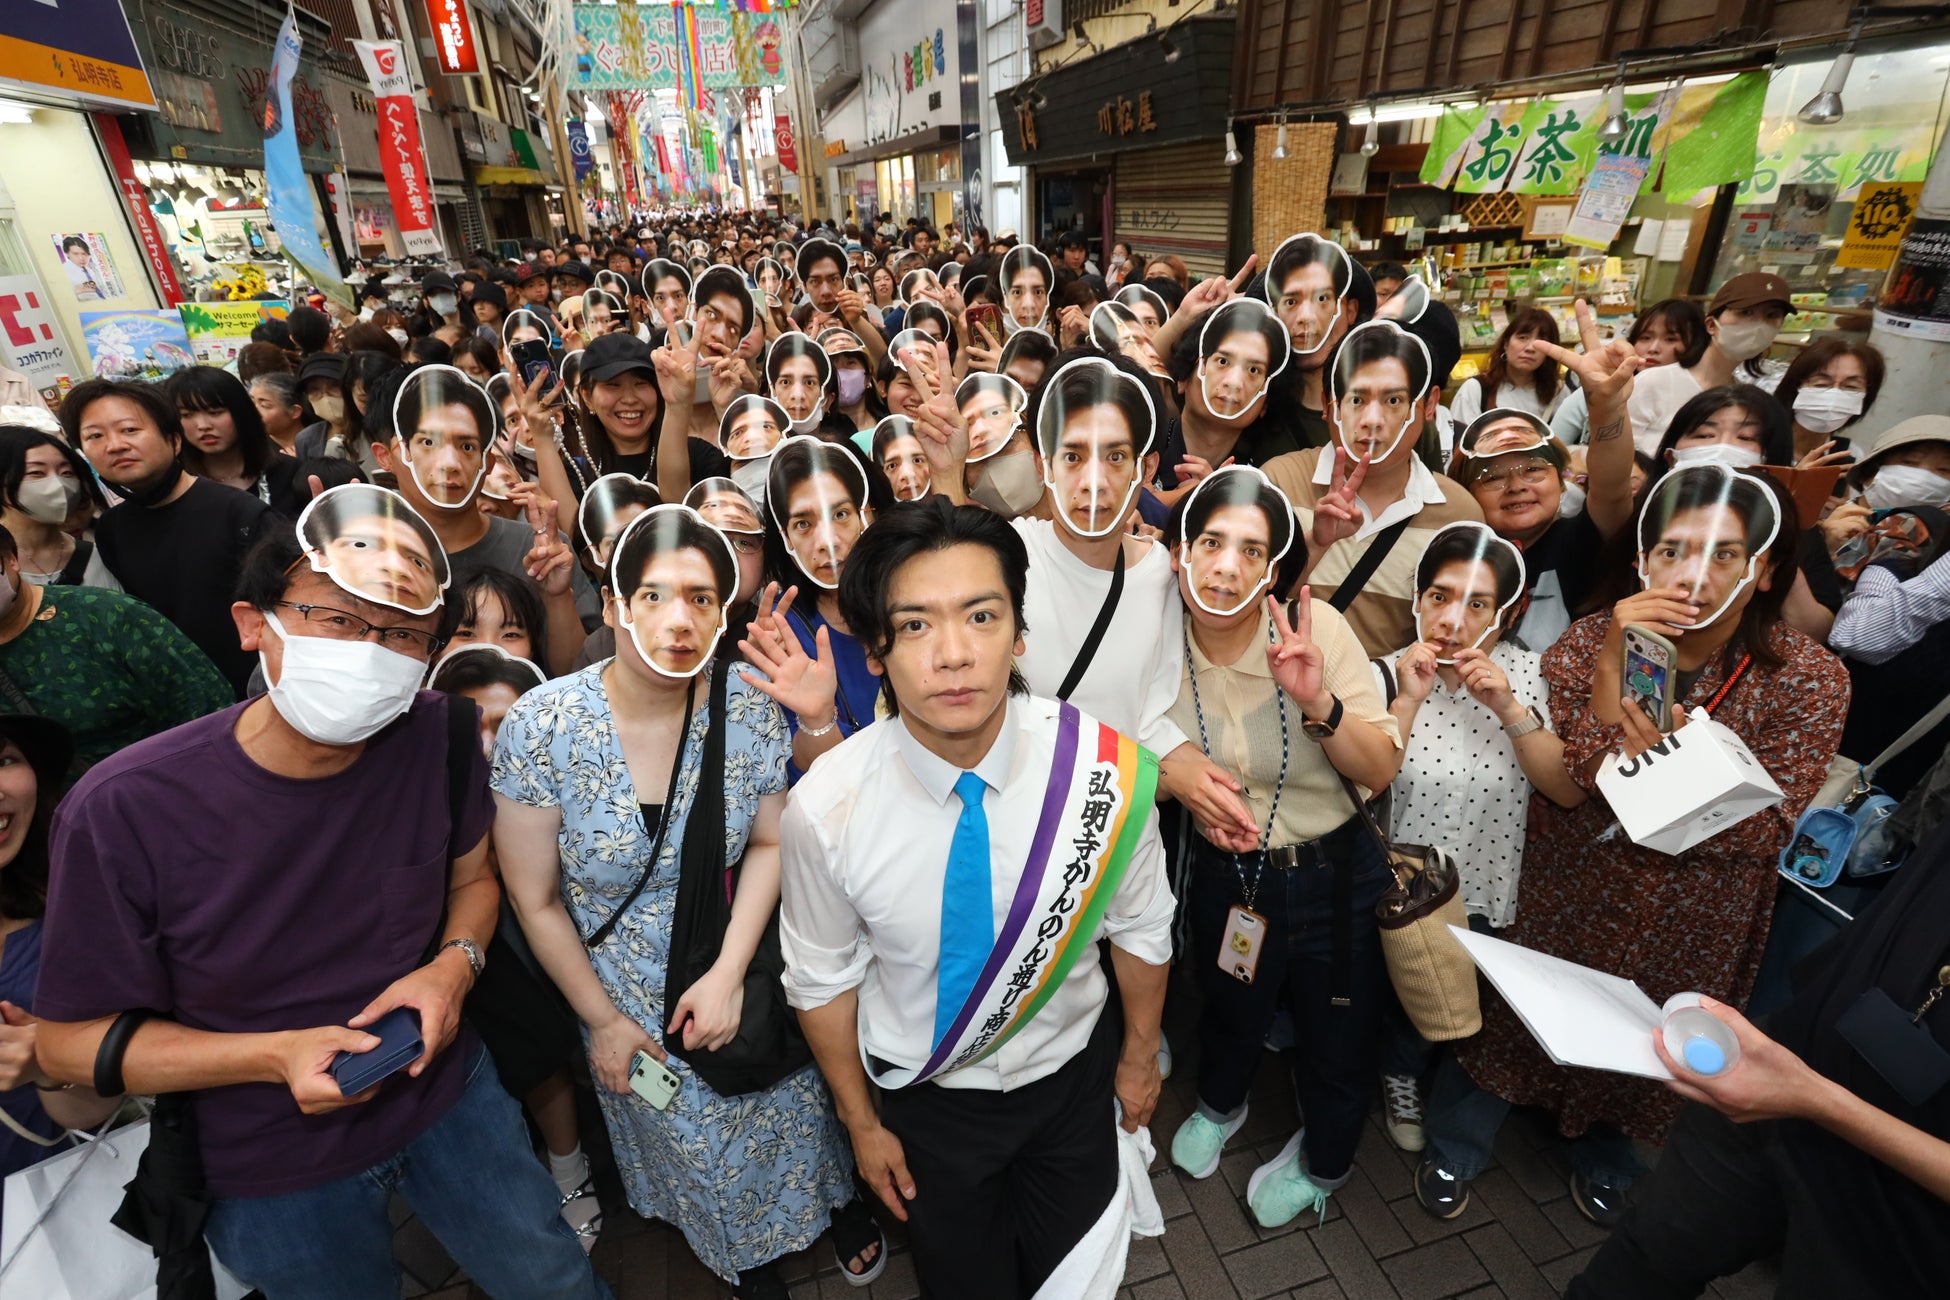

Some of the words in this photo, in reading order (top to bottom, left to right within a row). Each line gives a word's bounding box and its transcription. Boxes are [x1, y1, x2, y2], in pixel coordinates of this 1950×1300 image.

[68, 56, 124, 91] 弘明寺店
[1862, 203, 1900, 225] 110
[16, 347, 63, 367] ココカラファイン
